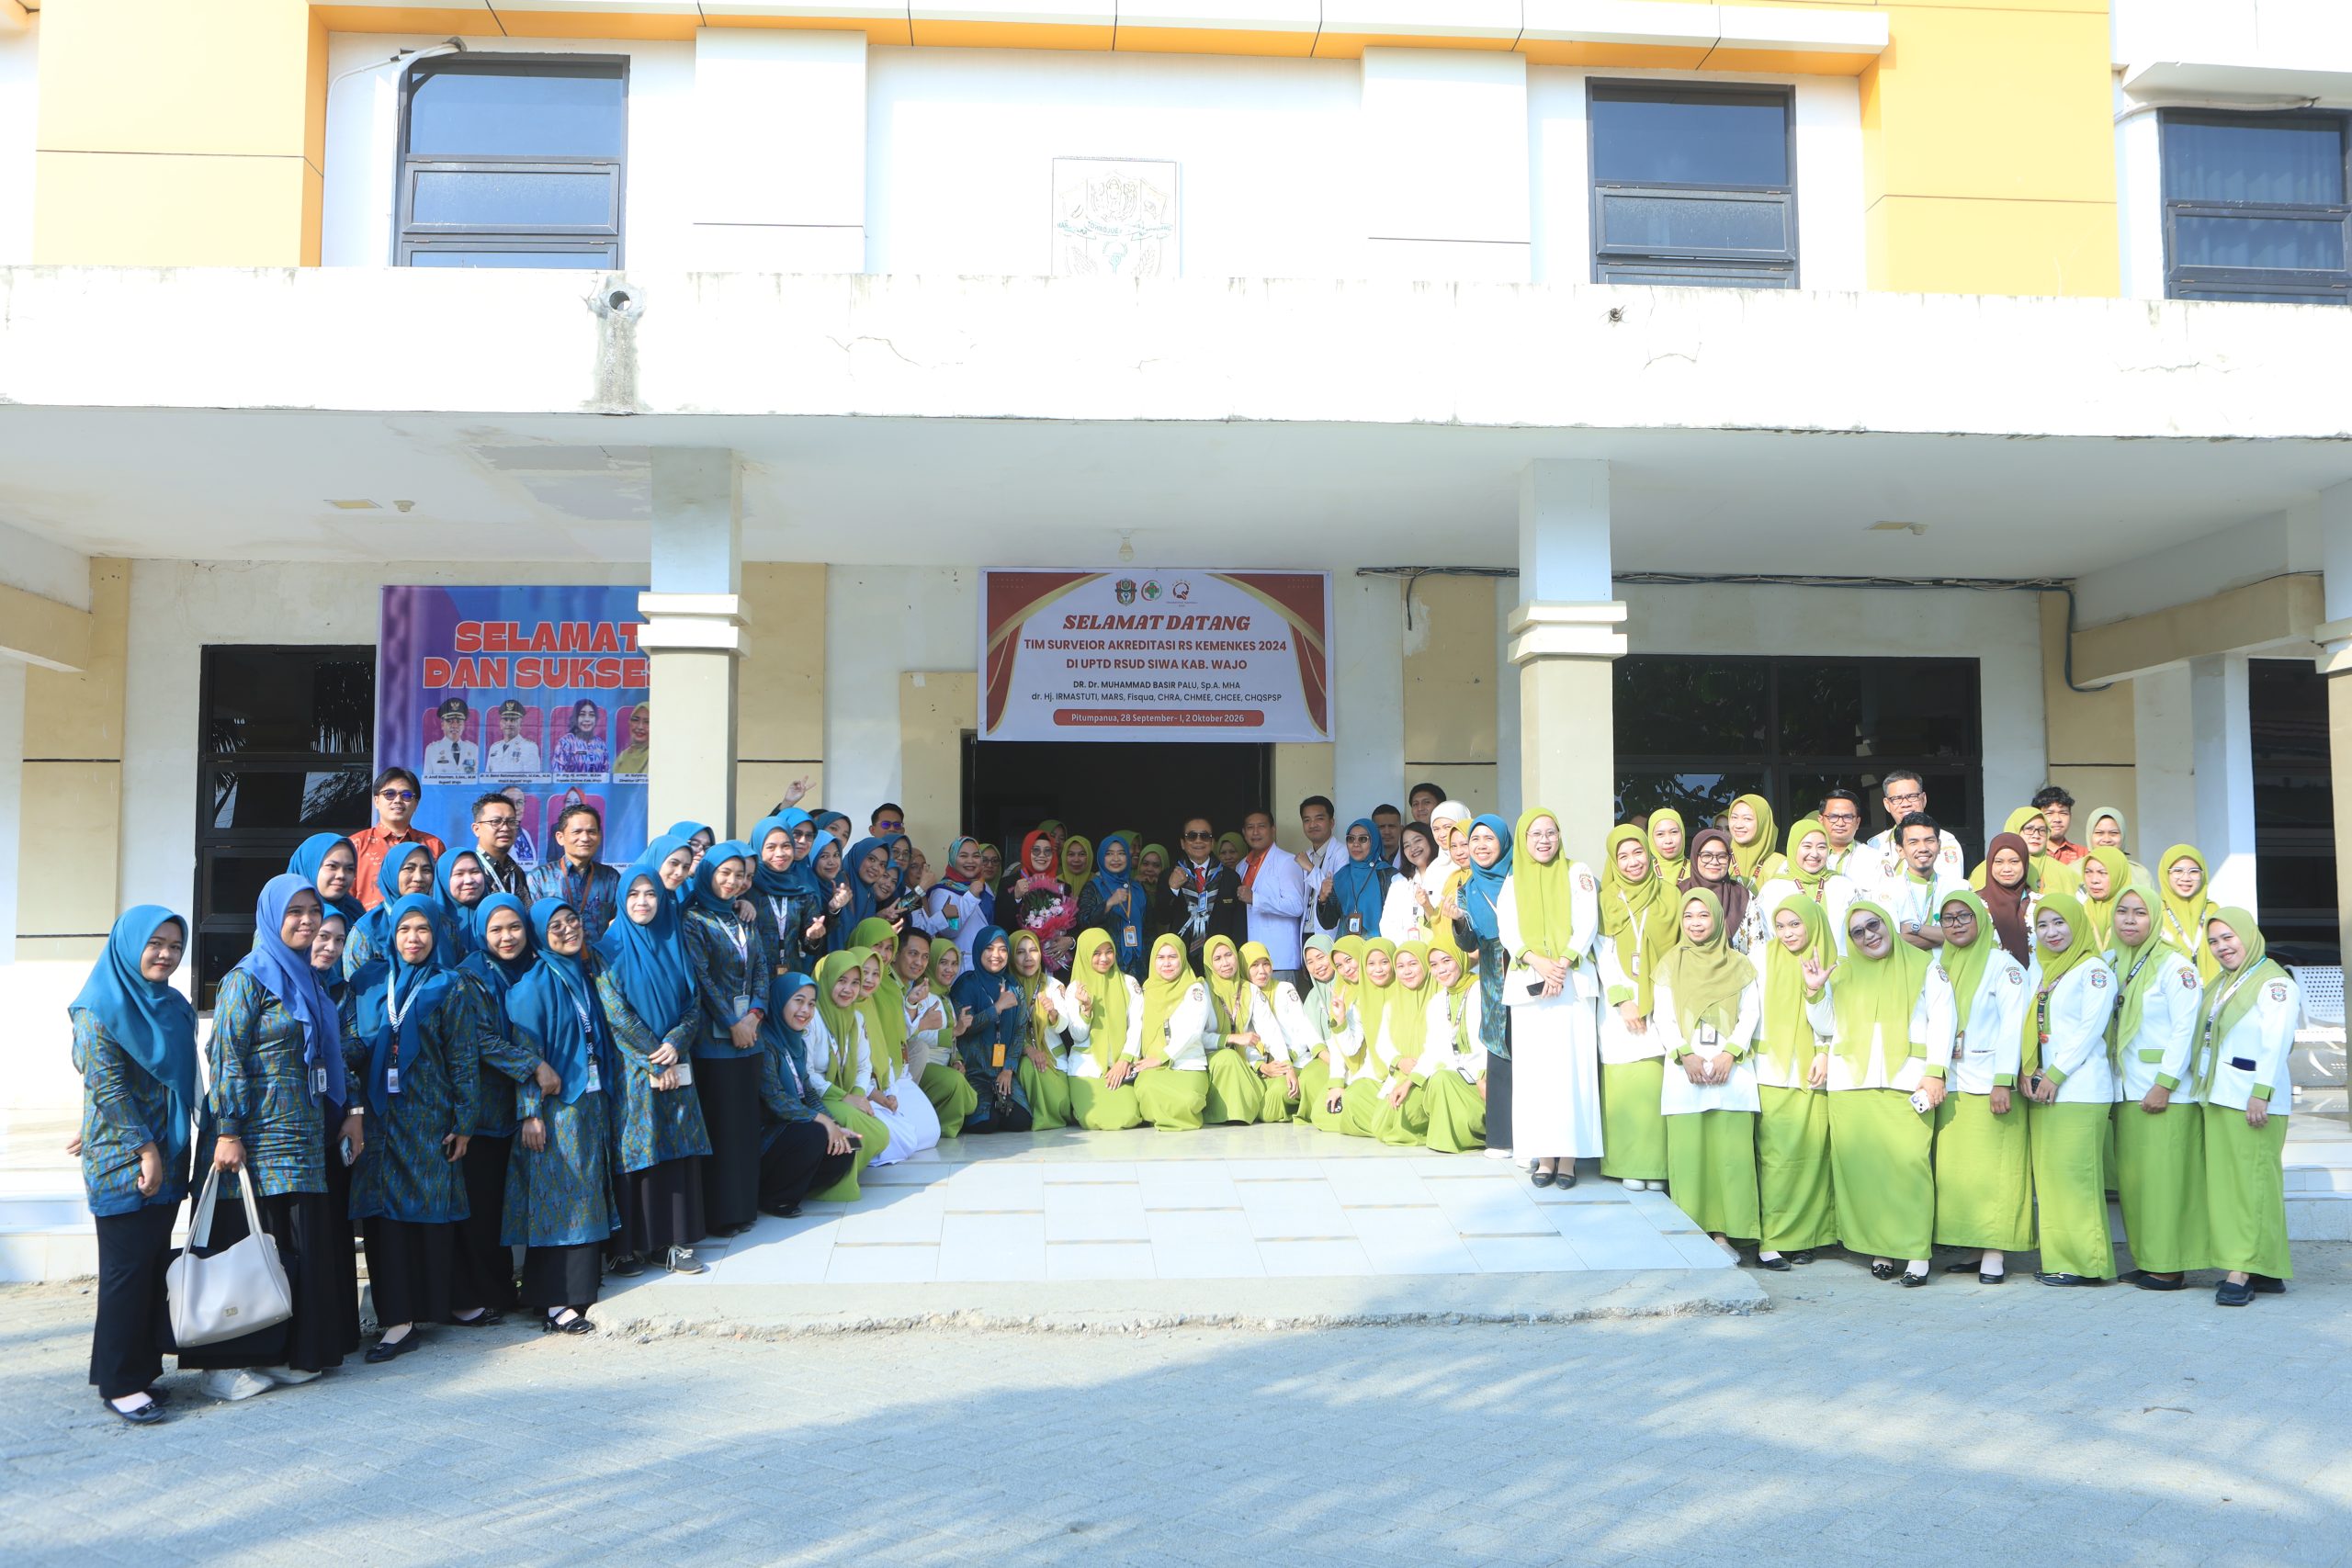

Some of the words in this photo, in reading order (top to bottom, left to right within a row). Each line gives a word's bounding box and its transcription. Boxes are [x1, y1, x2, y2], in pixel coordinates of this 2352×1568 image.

[1063, 615, 1164, 630] SELAMAT
[1165, 615, 1250, 631] DATANG
[455, 621, 639, 653] SELAMAT
[1024, 639, 1045, 649] TIM
[1047, 639, 1105, 650] SURVEIOR
[1108, 640, 1176, 650] AKREDITASI
[1178, 640, 1193, 650] RS
[1195, 641, 1256, 651] KEMENKES
[1259, 641, 1287, 651] 2024
[1066, 659, 1078, 669] DI
[1080, 659, 1111, 669] UPTD
[1114, 660, 1146, 669] RSUD
[1148, 660, 1179, 670] SIWA
[1182, 660, 1209, 670] KAB.
[1211, 660, 1248, 670] WAJO
[424, 657, 508, 689] DAN
[514, 657, 650, 689] SUKSE
[1073, 681, 1086, 689] DR.
[1088, 681, 1100, 689] Dr.
[1178, 682, 1199, 691] PALU,
[1201, 682, 1221, 691] Sp.A.
[1031, 693, 1042, 701] dr.
[1044, 694, 1054, 702] Hj.
[1056, 694, 1100, 702] IRMASTUTI,
[1101, 694, 1125, 702] MARS,
[1127, 694, 1156, 703] Fisqua,
[1158, 694, 1182, 702] CHRA,
[1183, 694, 1214, 703] CHMEE,
[1215, 694, 1243, 703] CHCEE,
[1071, 714, 1119, 723] Pitumpanua,
[1120, 714, 1131, 722] 28
[1132, 714, 1178, 724] September-
[1192, 714, 1223, 722] Oktober
[1224, 715, 1245, 723] 2026
